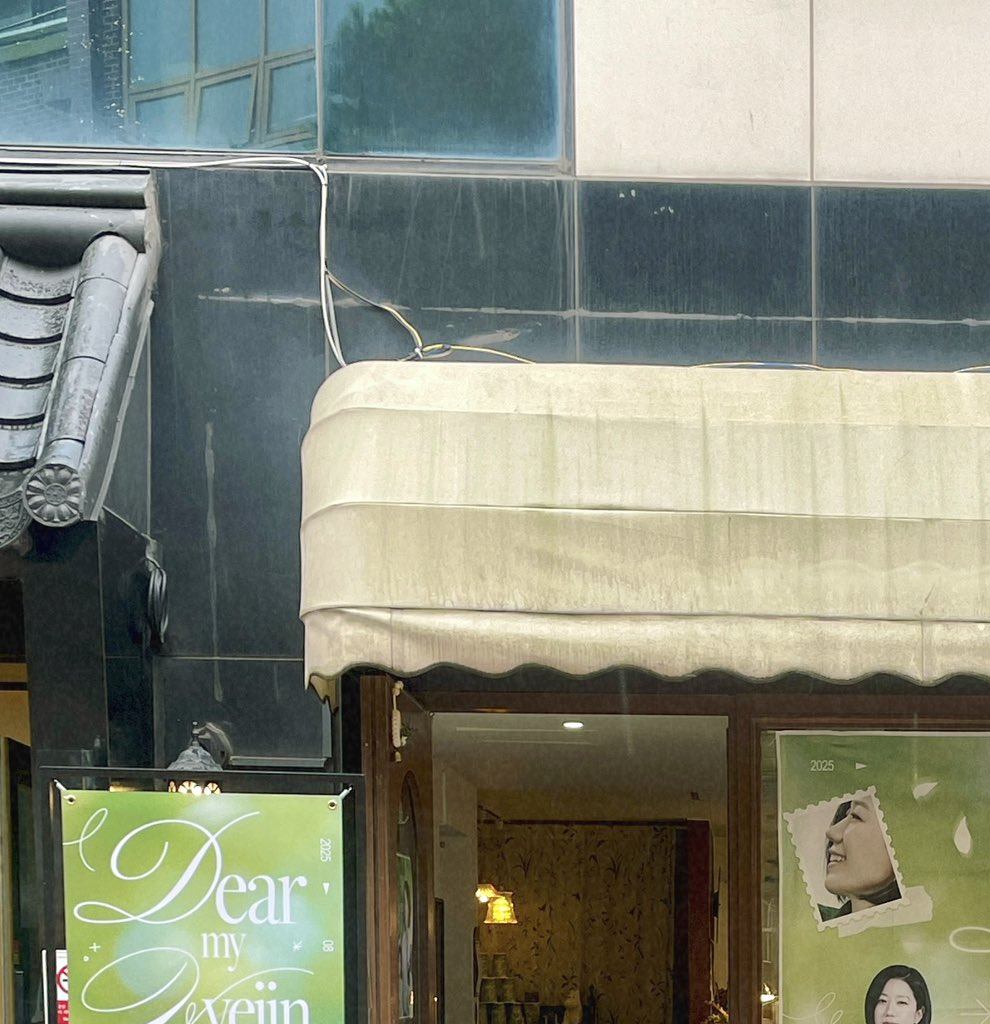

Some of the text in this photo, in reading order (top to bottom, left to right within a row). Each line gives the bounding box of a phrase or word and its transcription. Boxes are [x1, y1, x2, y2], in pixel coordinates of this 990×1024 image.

[810, 759, 834, 773] 2025
[319, 837, 332, 863] 2025
[73, 811, 308, 925] Dear
[201, 931, 247, 972] my
[322, 939, 334, 953] 08
